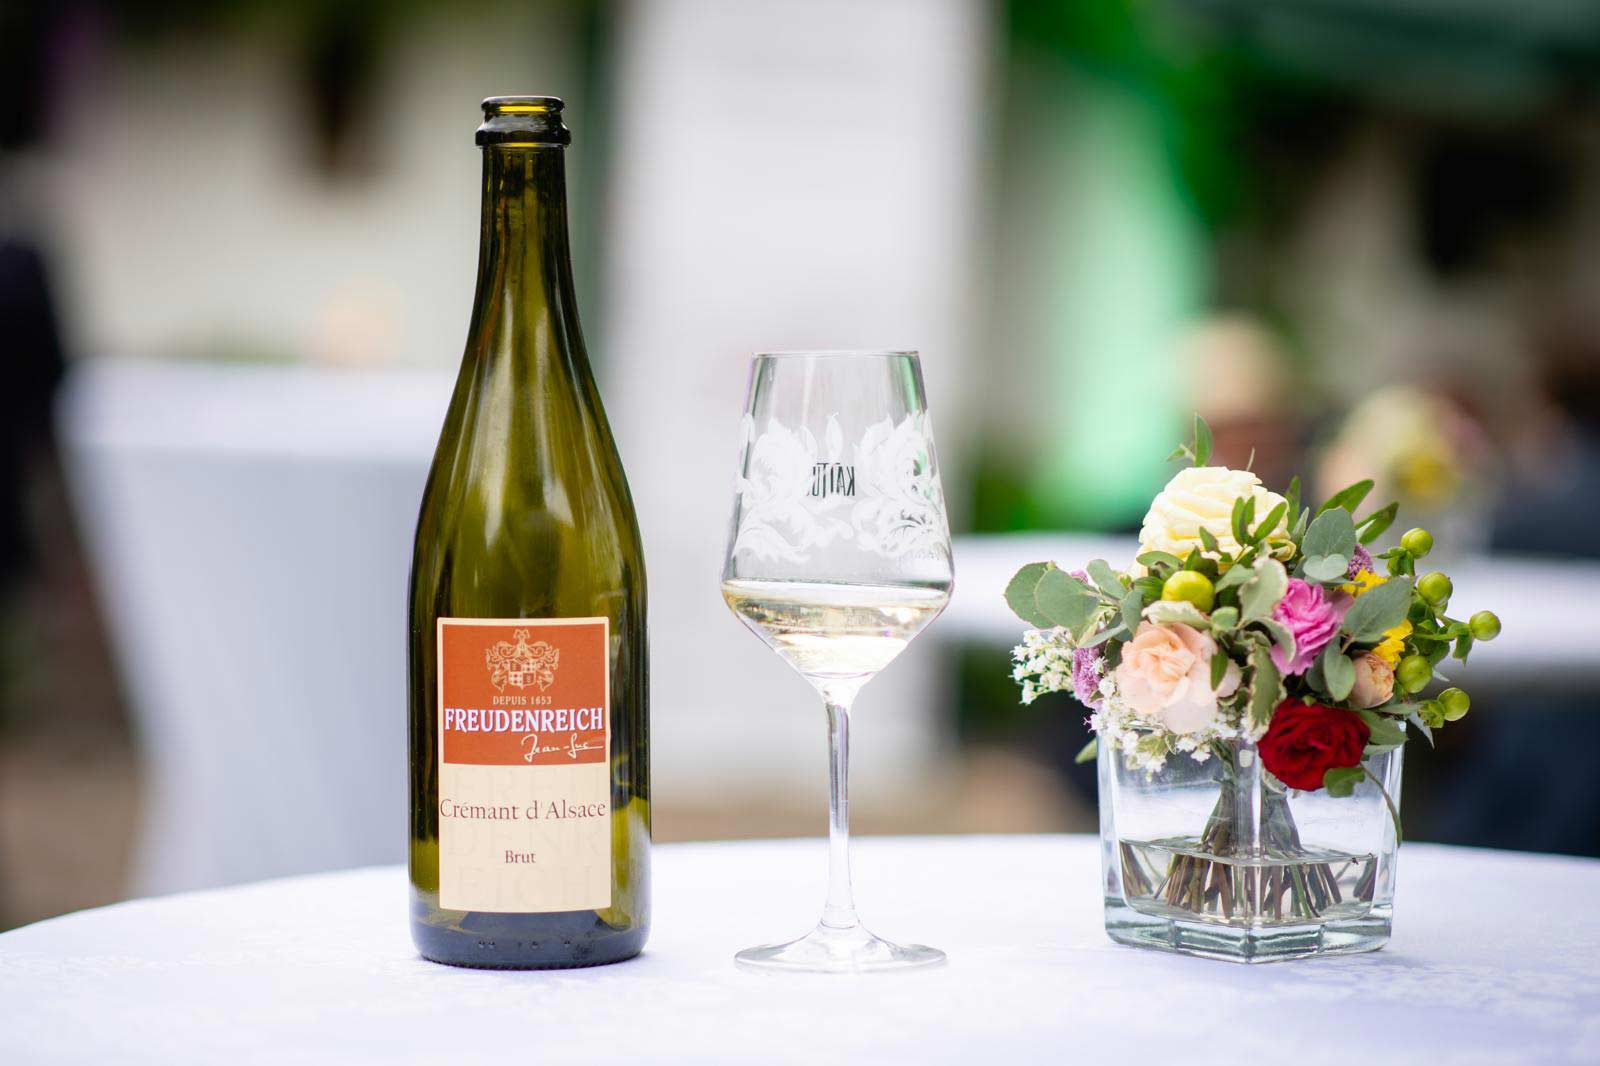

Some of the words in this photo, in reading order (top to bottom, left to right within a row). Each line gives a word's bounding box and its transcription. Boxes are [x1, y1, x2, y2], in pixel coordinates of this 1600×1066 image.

[492, 695, 527, 706] DEPUIS
[530, 695, 552, 706] 1653
[444, 707, 604, 734] FREUDENREICH
[440, 798, 519, 821] Crémant
[525, 798, 606, 820] d'Alsace
[504, 849, 537, 865] Brut
